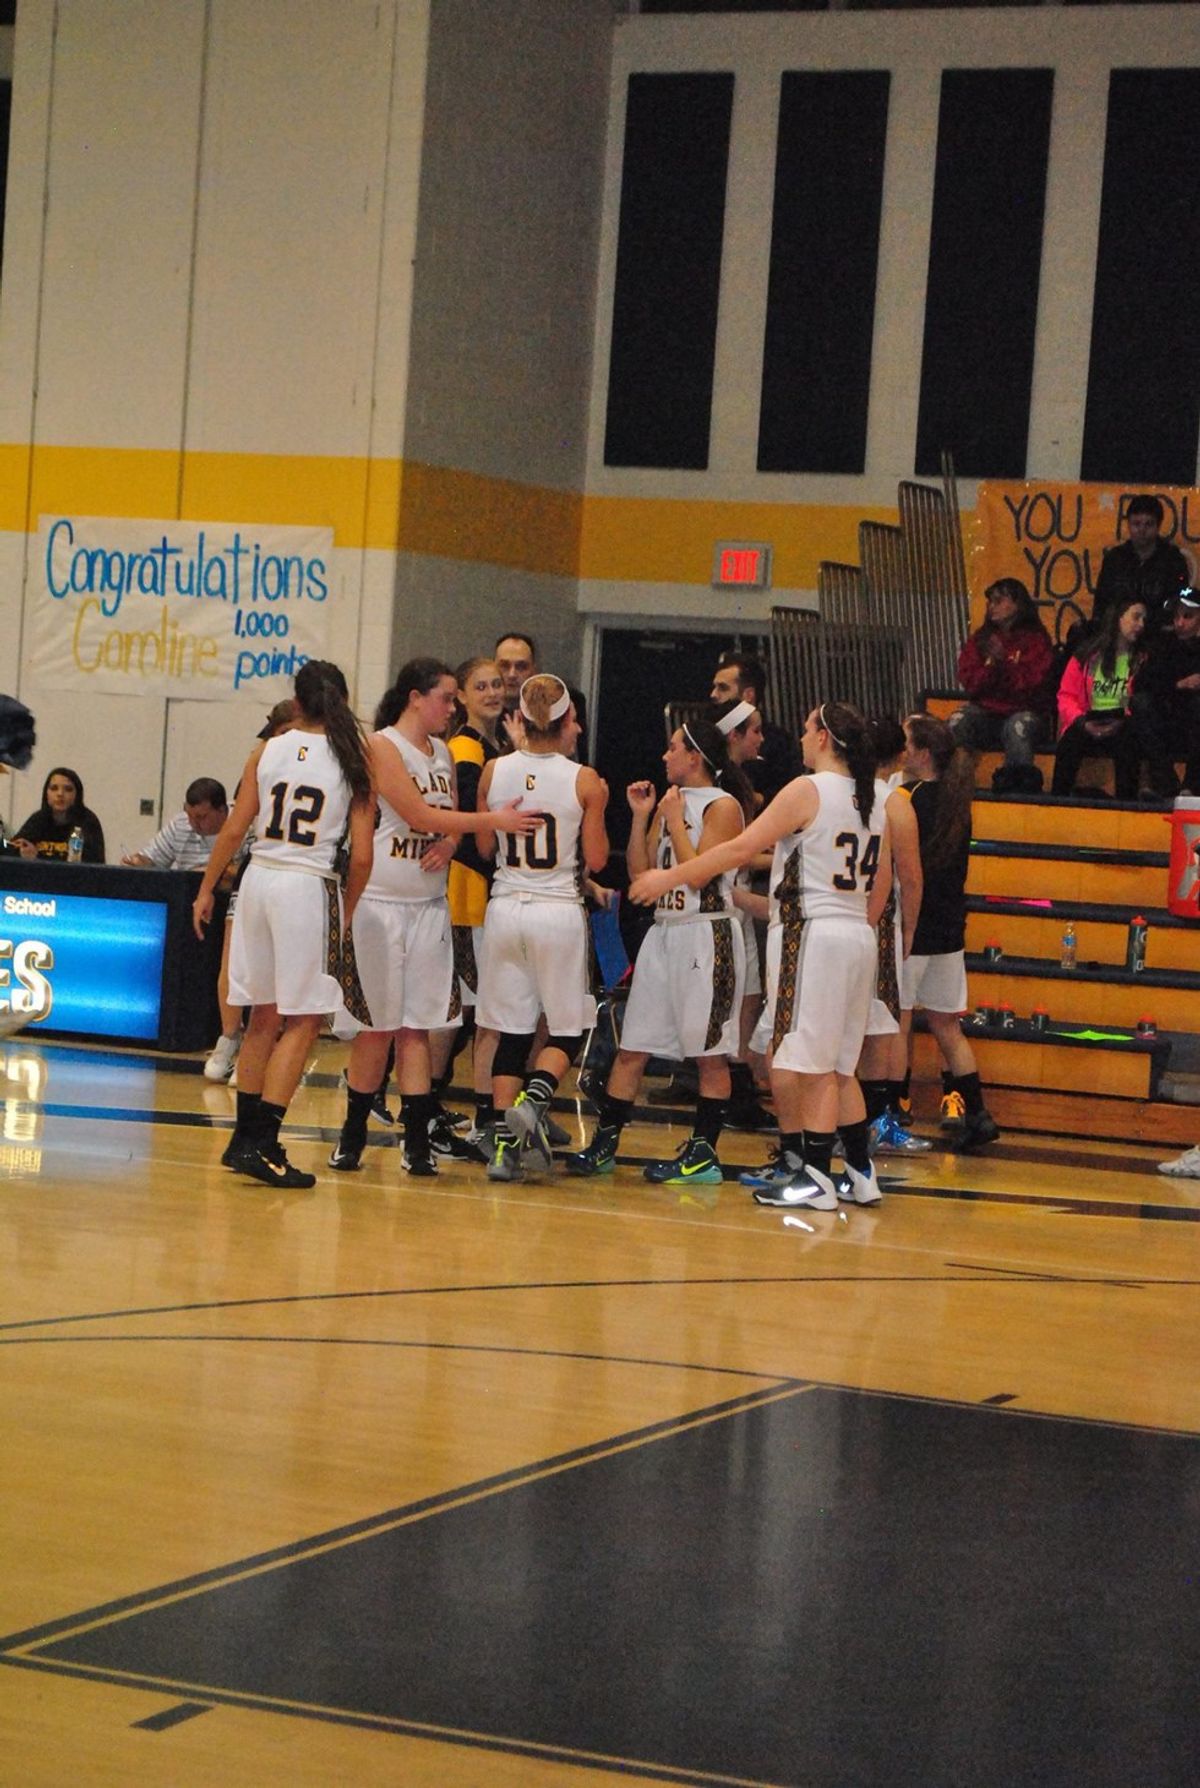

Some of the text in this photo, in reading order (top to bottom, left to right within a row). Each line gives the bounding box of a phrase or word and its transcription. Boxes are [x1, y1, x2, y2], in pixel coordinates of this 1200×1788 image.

[1004, 492, 1082, 542] YOU
[46, 519, 328, 617] Congratulations
[721, 550, 760, 584] EXIT
[235, 609, 289, 638] 1,000
[412, 771, 453, 800] LAD
[265, 782, 325, 847] 12
[505, 812, 558, 870] 10
[833, 831, 881, 892] 34
[4, 896, 56, 917] School
